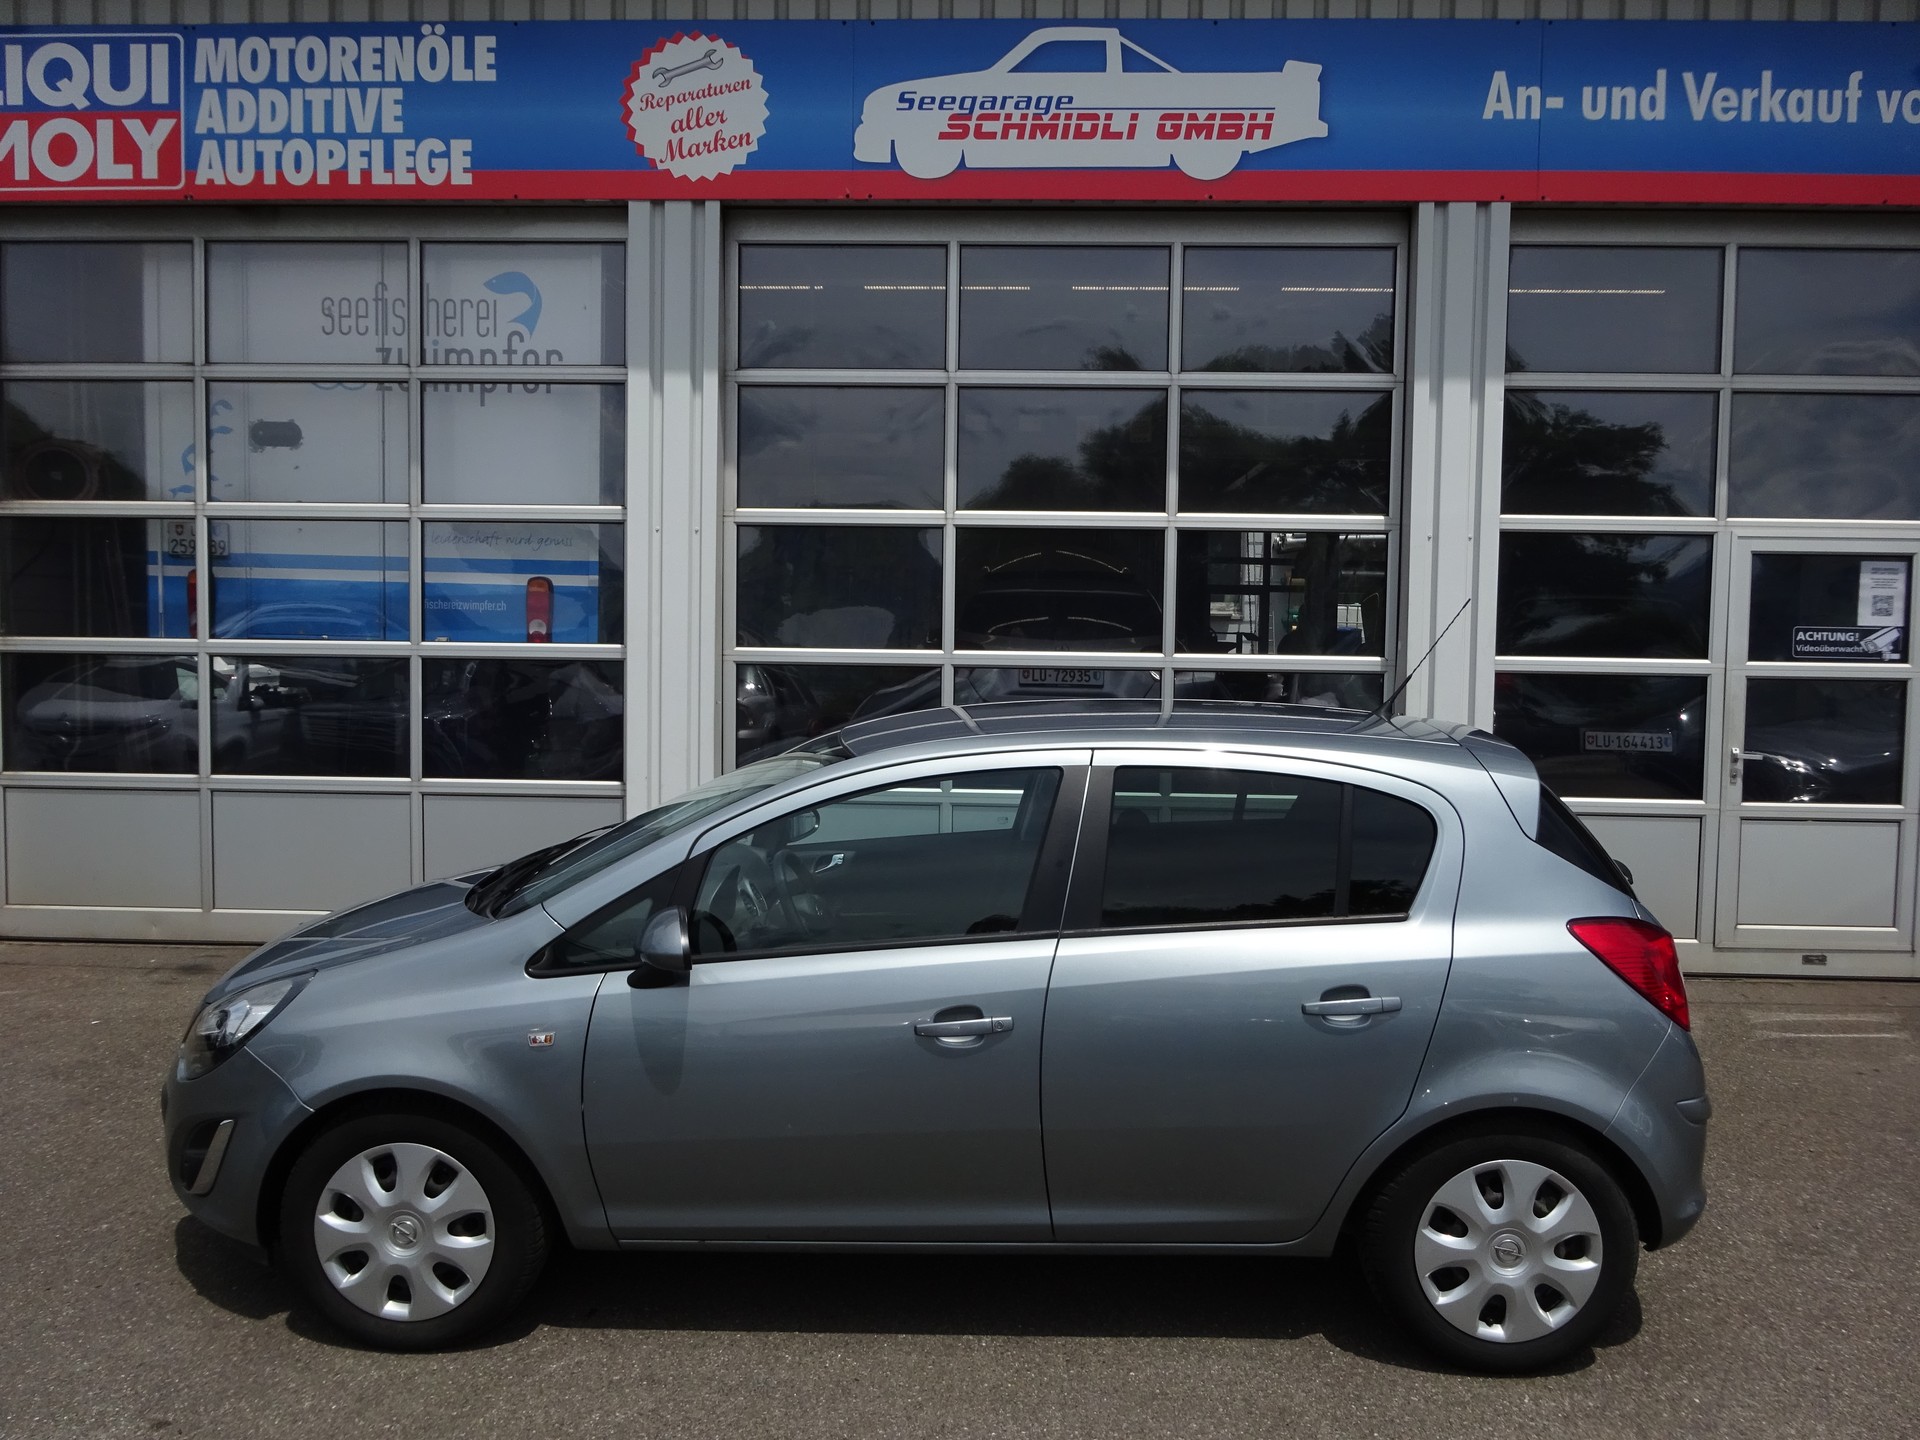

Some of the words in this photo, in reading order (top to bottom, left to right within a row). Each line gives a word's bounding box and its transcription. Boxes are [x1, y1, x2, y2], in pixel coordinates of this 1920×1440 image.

[194, 24, 497, 83] MOTORENÖLE
[0, 42, 169, 110] IQUI
[194, 88, 403, 134] ADDITIVE
[640, 79, 753, 112] Reparaturen
[896, 91, 1074, 116] Seegarage
[1483, 71, 1564, 120] An-
[1582, 69, 1667, 121] und
[1682, 70, 1864, 123] Verkauf
[670, 106, 728, 134] aller
[938, 112, 1137, 140] SCHMIDLI
[1156, 112, 1276, 140] GMBH
[194, 139, 473, 186] AUTOPFLEGE
[659, 129, 754, 163] Marken
[1795, 631, 1860, 642] ACHTUNG!
[1795, 644, 1863, 654] Videoüberwacht
